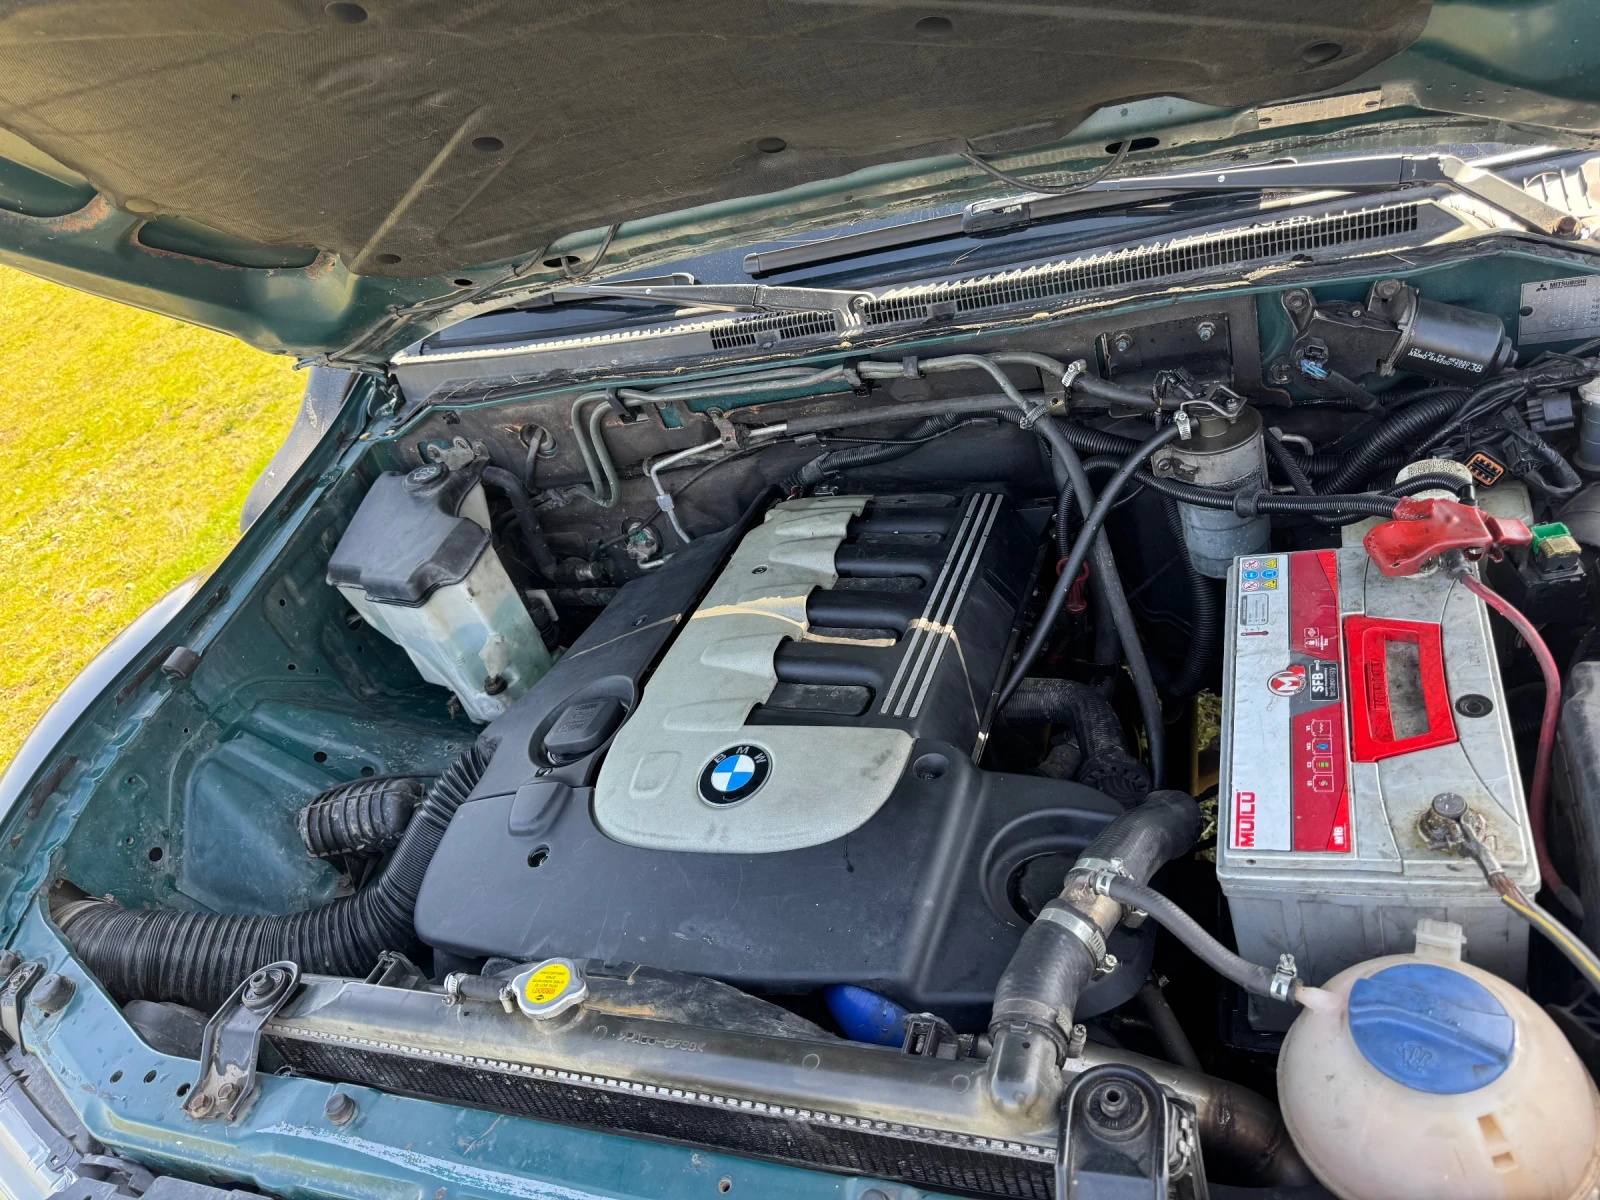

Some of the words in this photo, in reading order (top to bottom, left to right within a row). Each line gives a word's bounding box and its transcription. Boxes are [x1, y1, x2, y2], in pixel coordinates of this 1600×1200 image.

[1549, 279, 1587, 288] MITSUBISHI
[1311, 672, 1324, 693] SFB
[713, 746, 767, 764] BMW
[1235, 791, 1255, 847] MUTLU
